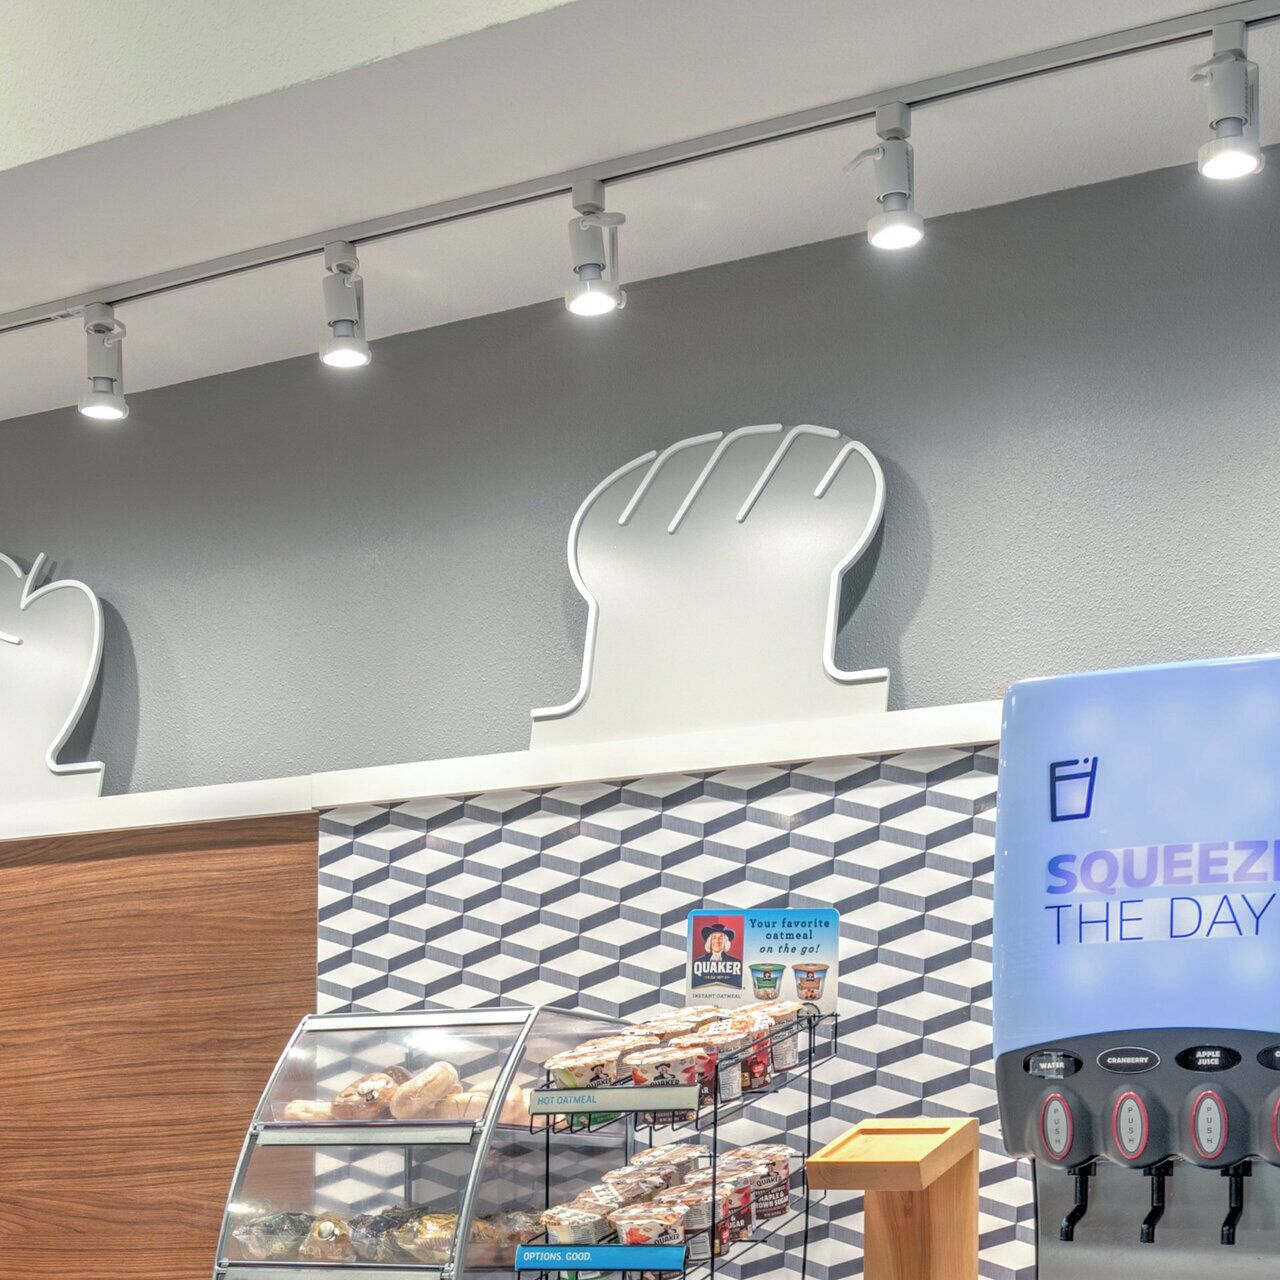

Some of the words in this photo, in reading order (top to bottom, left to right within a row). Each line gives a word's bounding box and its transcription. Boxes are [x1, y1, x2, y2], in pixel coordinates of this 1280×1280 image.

[749, 918, 777, 928] Your
[782, 918, 830, 928] favorite
[1045, 899, 1144, 944] THE
[1170, 893, 1276, 938] DAY
[766, 929, 813, 940] oatmeal
[759, 945, 773, 954] on
[778, 943, 797, 954] the
[800, 944, 821, 956] go!
[693, 961, 742, 976] QUAKER
[1039, 1061, 1065, 1070] WATER
[1107, 1056, 1150, 1064] CRANBERRY
[537, 1096, 554, 1105] HOT
[556, 1094, 597, 1105] OATMEAL
[523, 1252, 563, 1261] OPTIONS.
[566, 1252, 592, 1261] GOOD.
